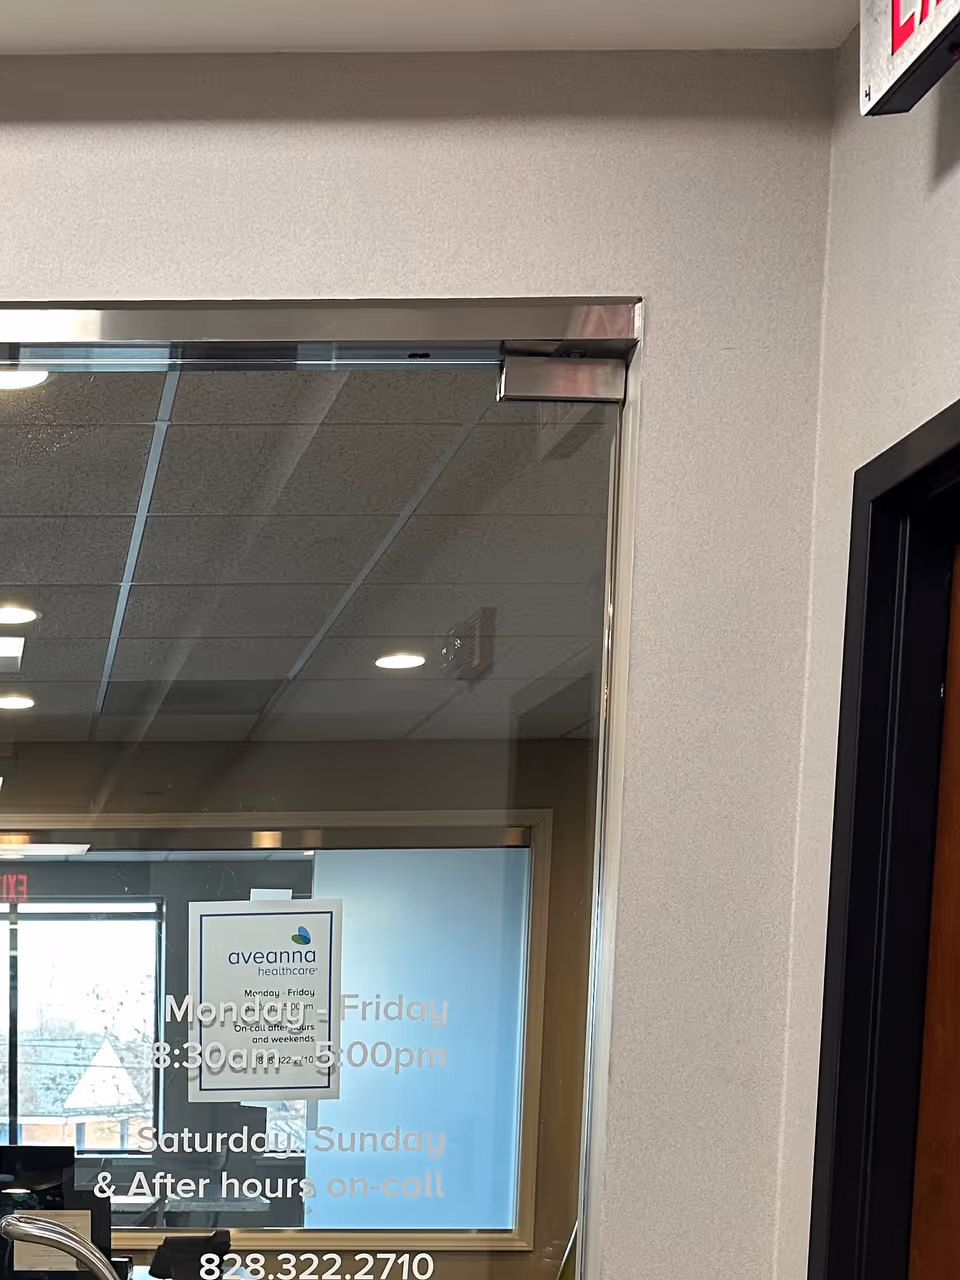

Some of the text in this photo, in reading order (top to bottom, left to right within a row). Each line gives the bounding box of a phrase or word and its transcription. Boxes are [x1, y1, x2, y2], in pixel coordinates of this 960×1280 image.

[228, 950, 316, 965] aveanna
[258, 966, 316, 977] healthcare
[287, 988, 315, 998] Friday
[165, 994, 306, 1029] Monday
[341, 993, 449, 1028] Friday
[271, 1034, 315, 1043] weekends
[150, 1041, 280, 1069] 8:30am
[315, 1040, 447, 1074] 5:00pm
[314, 1125, 446, 1158] Sunday
[93, 1169, 446, 1198] & After hours on-call
[199, 1253, 435, 1280] 828.322.2710
